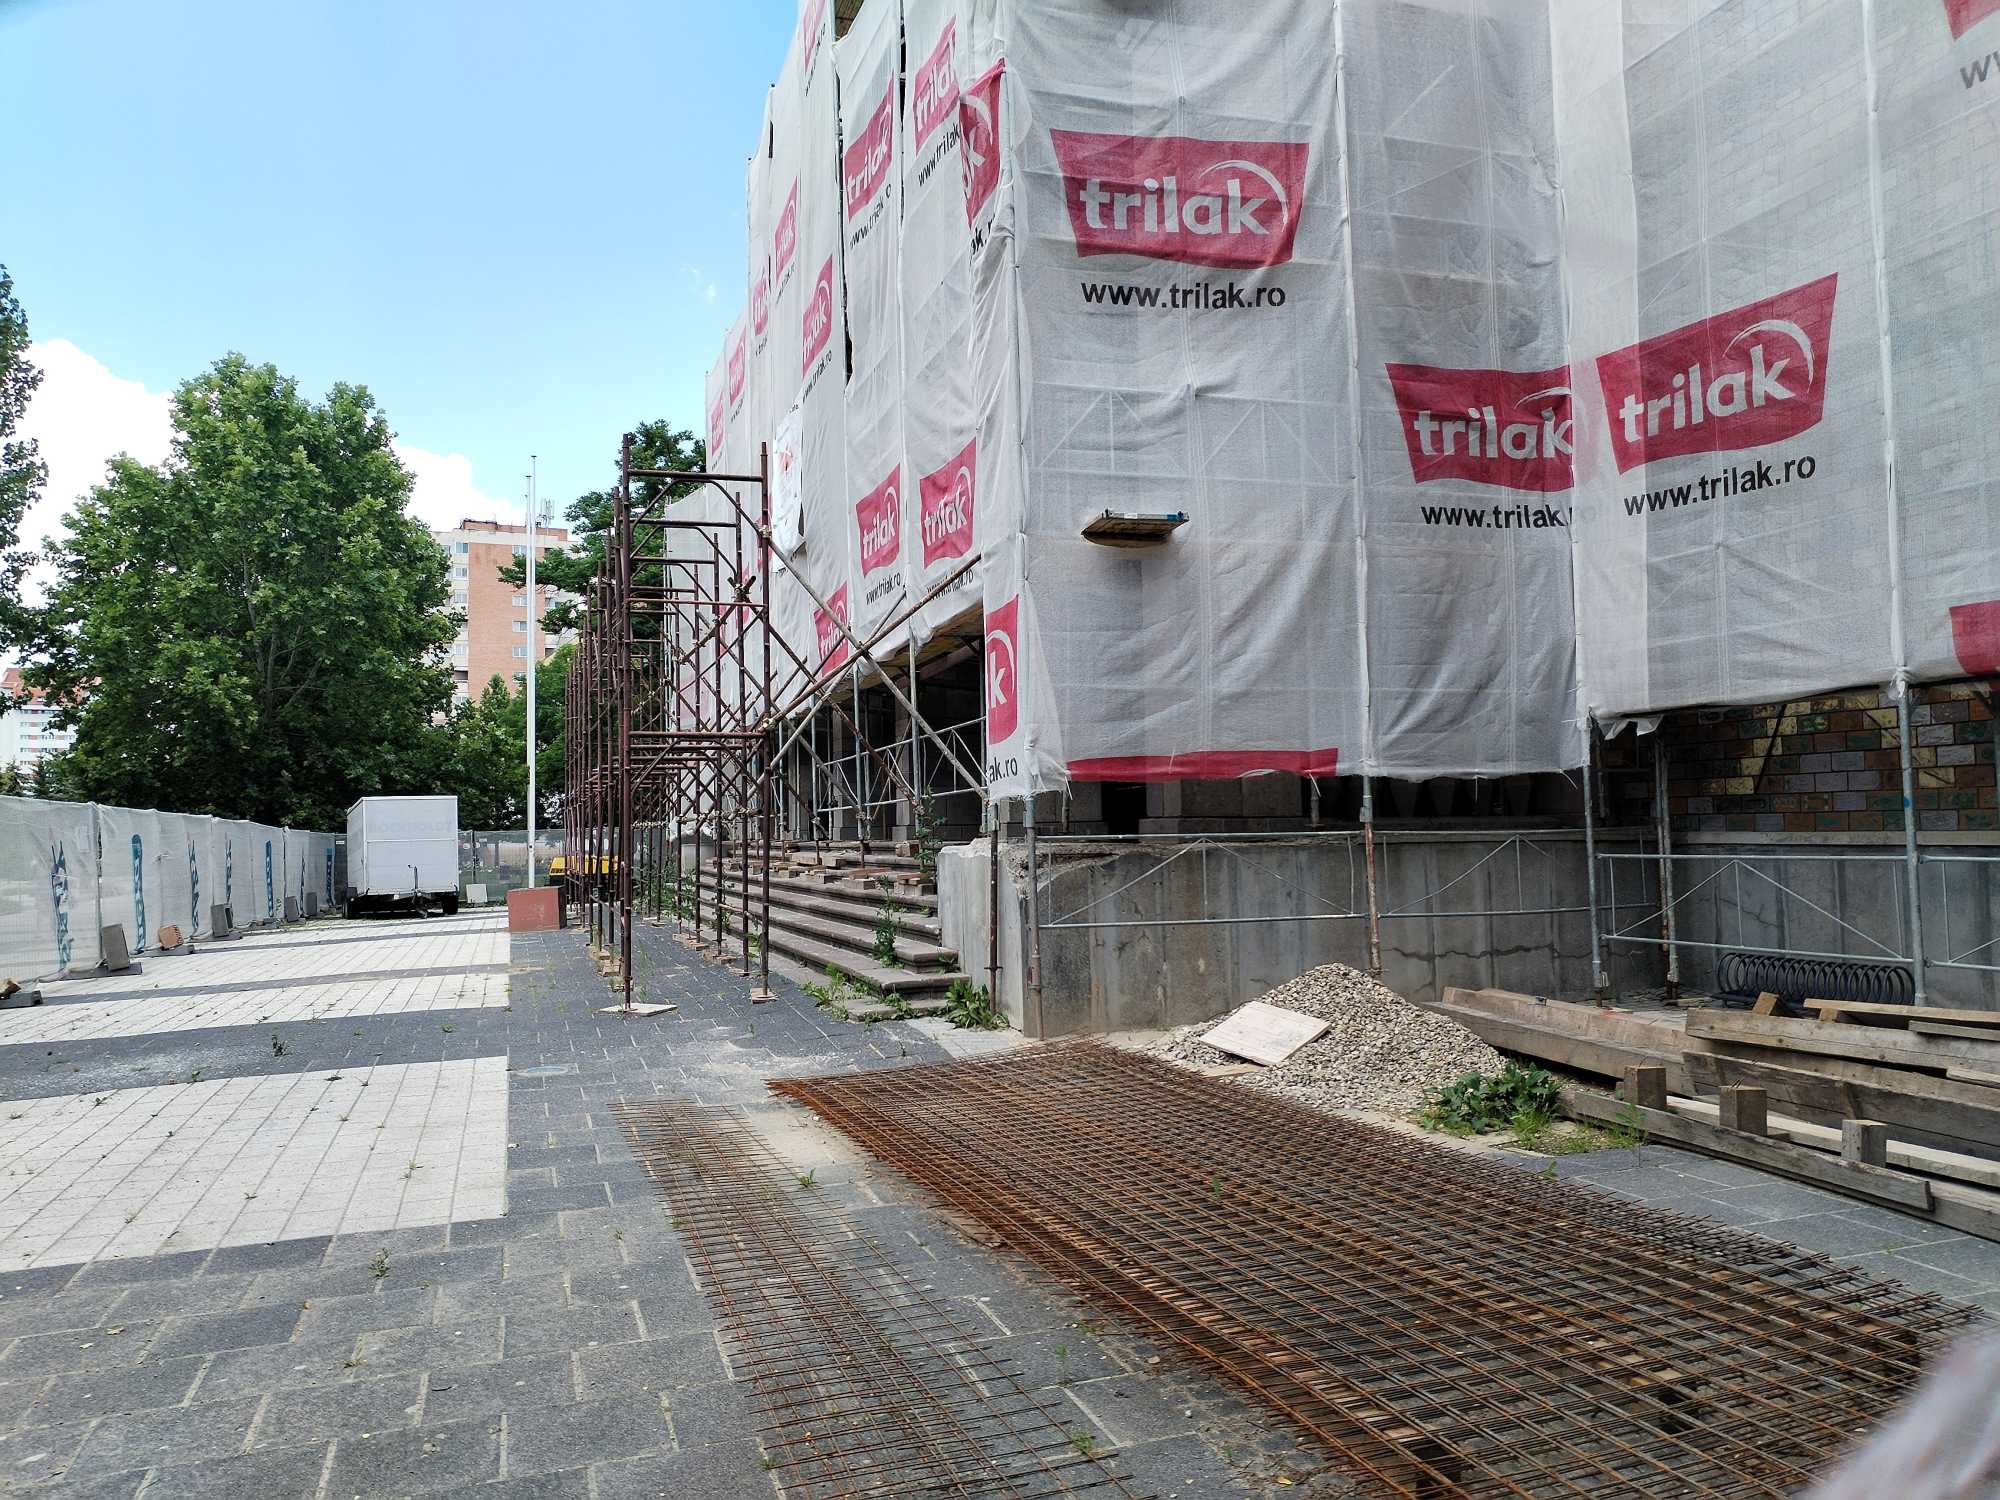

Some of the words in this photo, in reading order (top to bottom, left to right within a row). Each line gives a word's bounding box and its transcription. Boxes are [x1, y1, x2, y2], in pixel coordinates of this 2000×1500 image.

[1079, 175, 1270, 235] trilak
[1081, 282, 1286, 309] www.trilak.ro
[1619, 344, 1796, 443] trilak
[1414, 405, 1574, 460] trilak
[924, 483, 968, 546] trilak
[1624, 455, 1817, 516] www.trilak.ro
[863, 502, 896, 560] trilak
